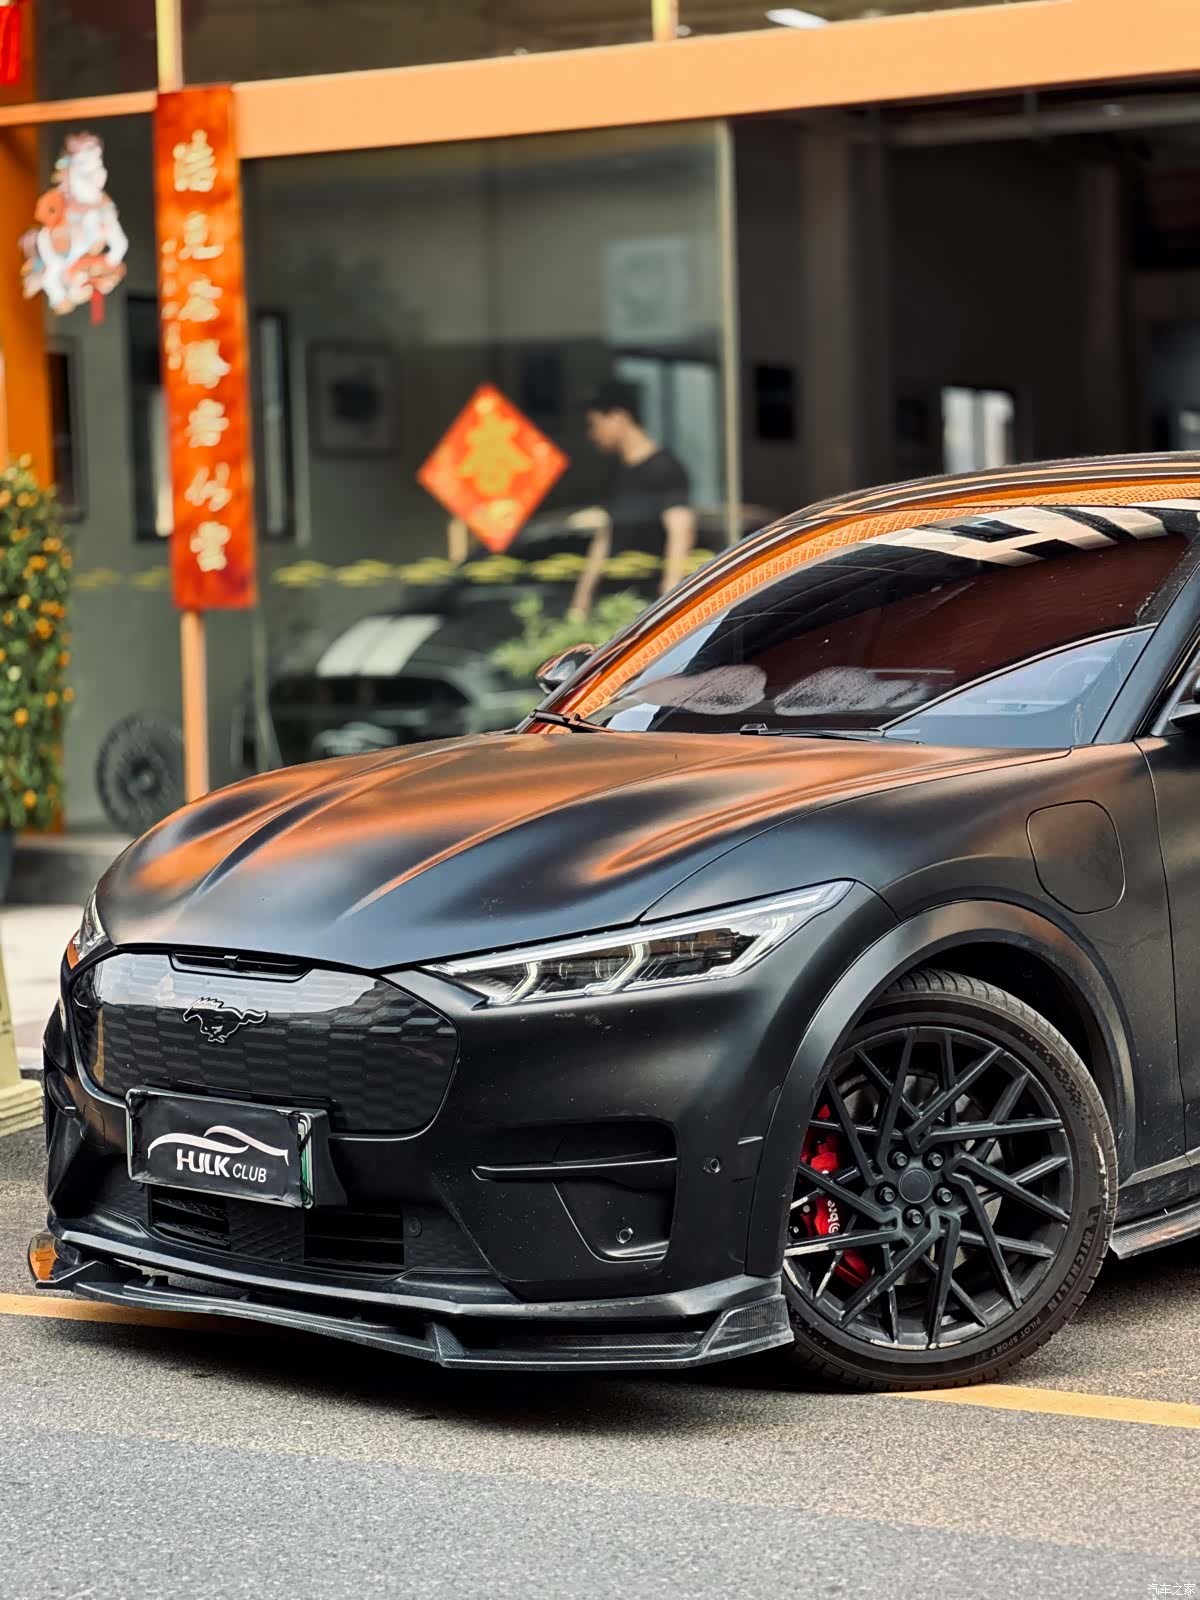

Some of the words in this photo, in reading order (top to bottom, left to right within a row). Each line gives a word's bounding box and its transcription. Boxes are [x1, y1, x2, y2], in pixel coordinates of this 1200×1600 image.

[176, 1149, 230, 1177] HULK
[232, 1162, 267, 1183] CLUB
[1047, 1229, 1094, 1312] MICHELIN
[1020, 1317, 1042, 1339] PILOT
[991, 1335, 1019, 1356] SPORT
